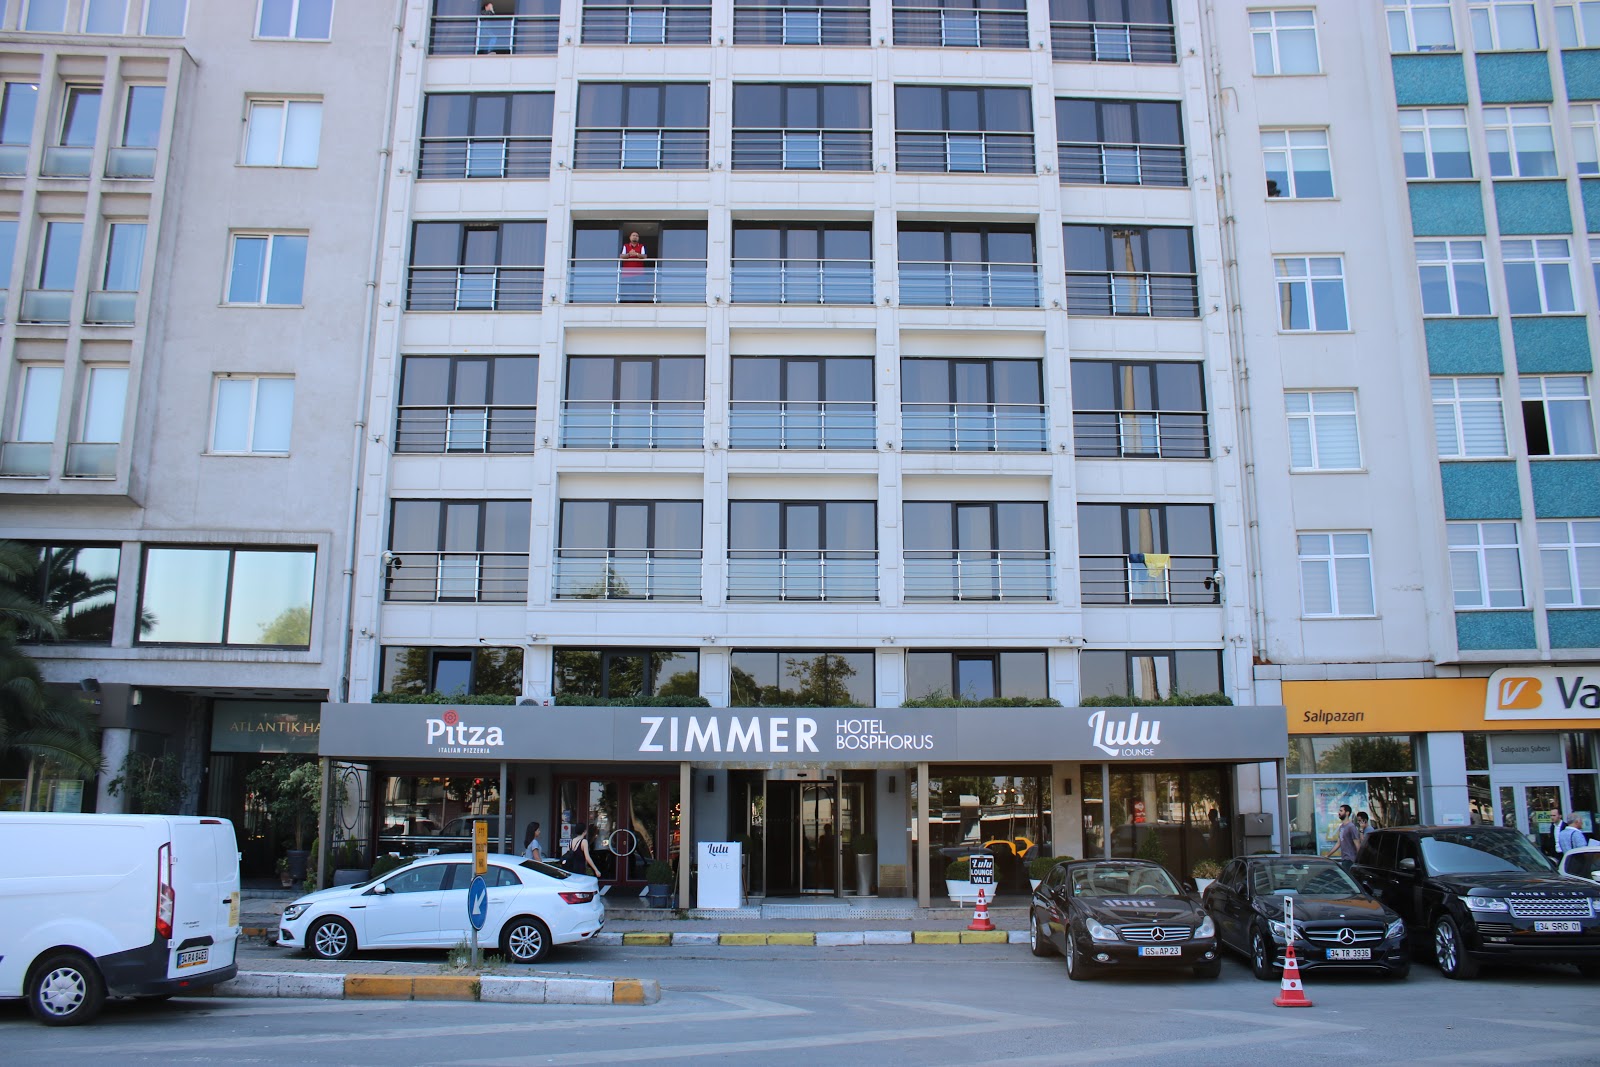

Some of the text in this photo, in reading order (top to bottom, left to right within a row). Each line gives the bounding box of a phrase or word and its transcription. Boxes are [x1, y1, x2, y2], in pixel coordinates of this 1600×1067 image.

[1556, 676, 1600, 709] Va
[1303, 709, 1364, 725] Salıpazarı
[230, 722, 300, 733] ATLANTIK
[426, 709, 505, 746] Pitza
[638, 716, 820, 753] ZIMMER
[835, 719, 886, 735] HOTEL
[1087, 710, 1161, 757] Lulu
[836, 734, 934, 750] BOSPHORUS
[1121, 748, 1155, 757] LOUNGE
[707, 843, 729, 857] Lulu
[971, 859, 992, 868] Lulu
[1540, 922, 1549, 931] 34
[1552, 922, 1569, 931] SRG
[1145, 947, 1179, 955] GS AP 23
